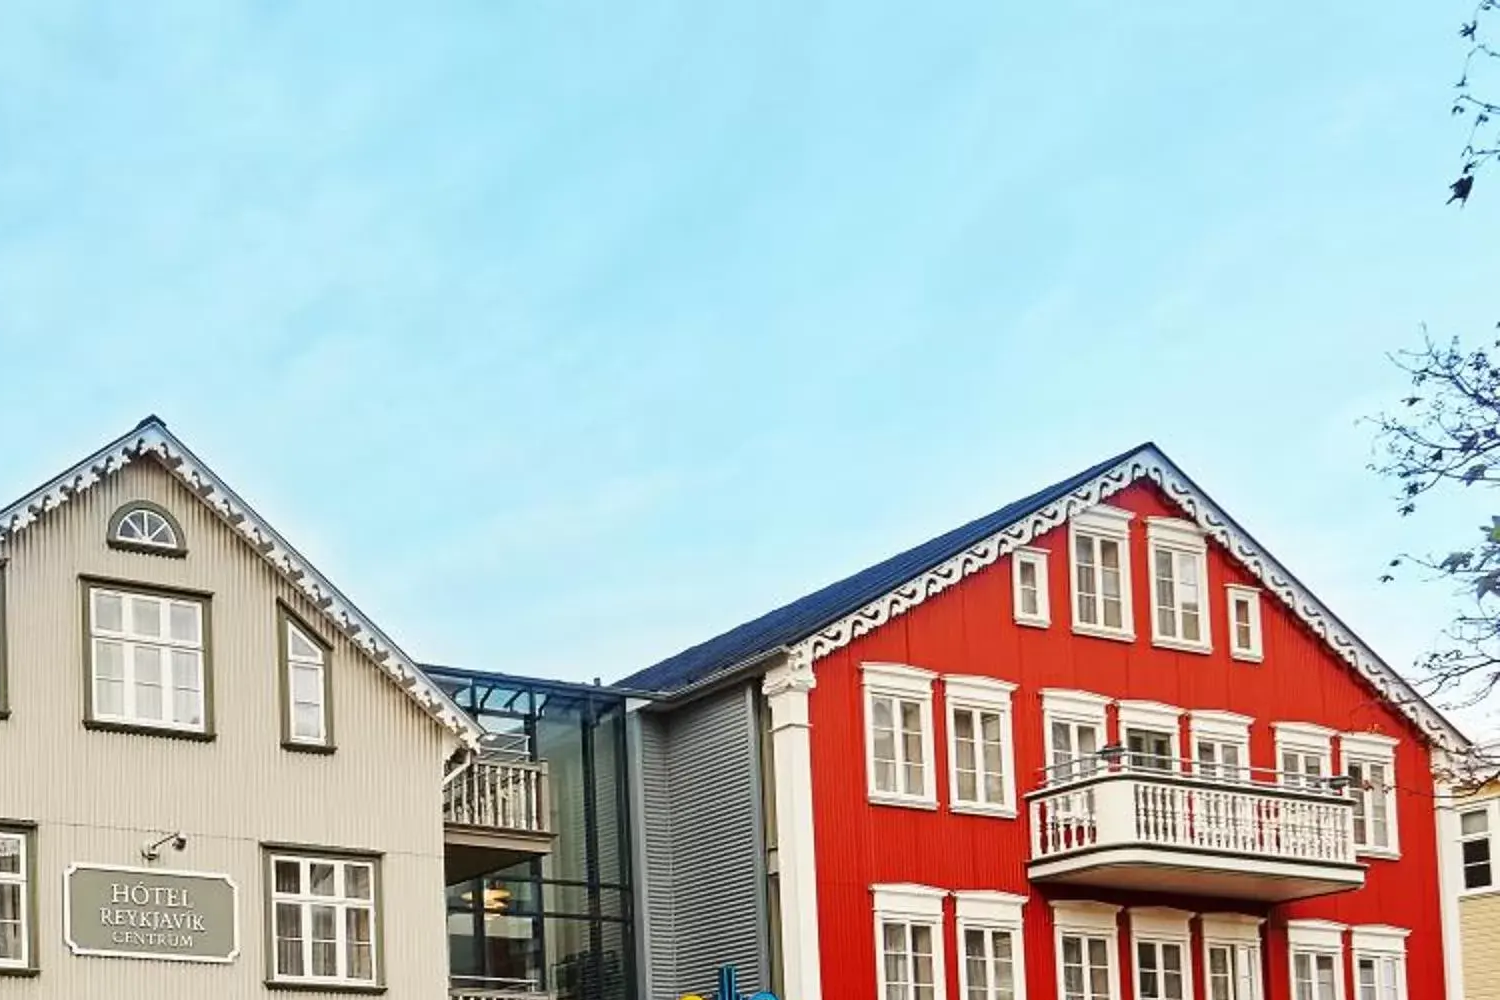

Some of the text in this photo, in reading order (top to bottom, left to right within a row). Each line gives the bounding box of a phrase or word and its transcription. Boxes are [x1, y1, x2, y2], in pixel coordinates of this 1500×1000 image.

[111, 881, 194, 908] HÓTEL
[100, 907, 206, 932] REYKJAVÍK
[112, 931, 193, 947] CENTRUM
